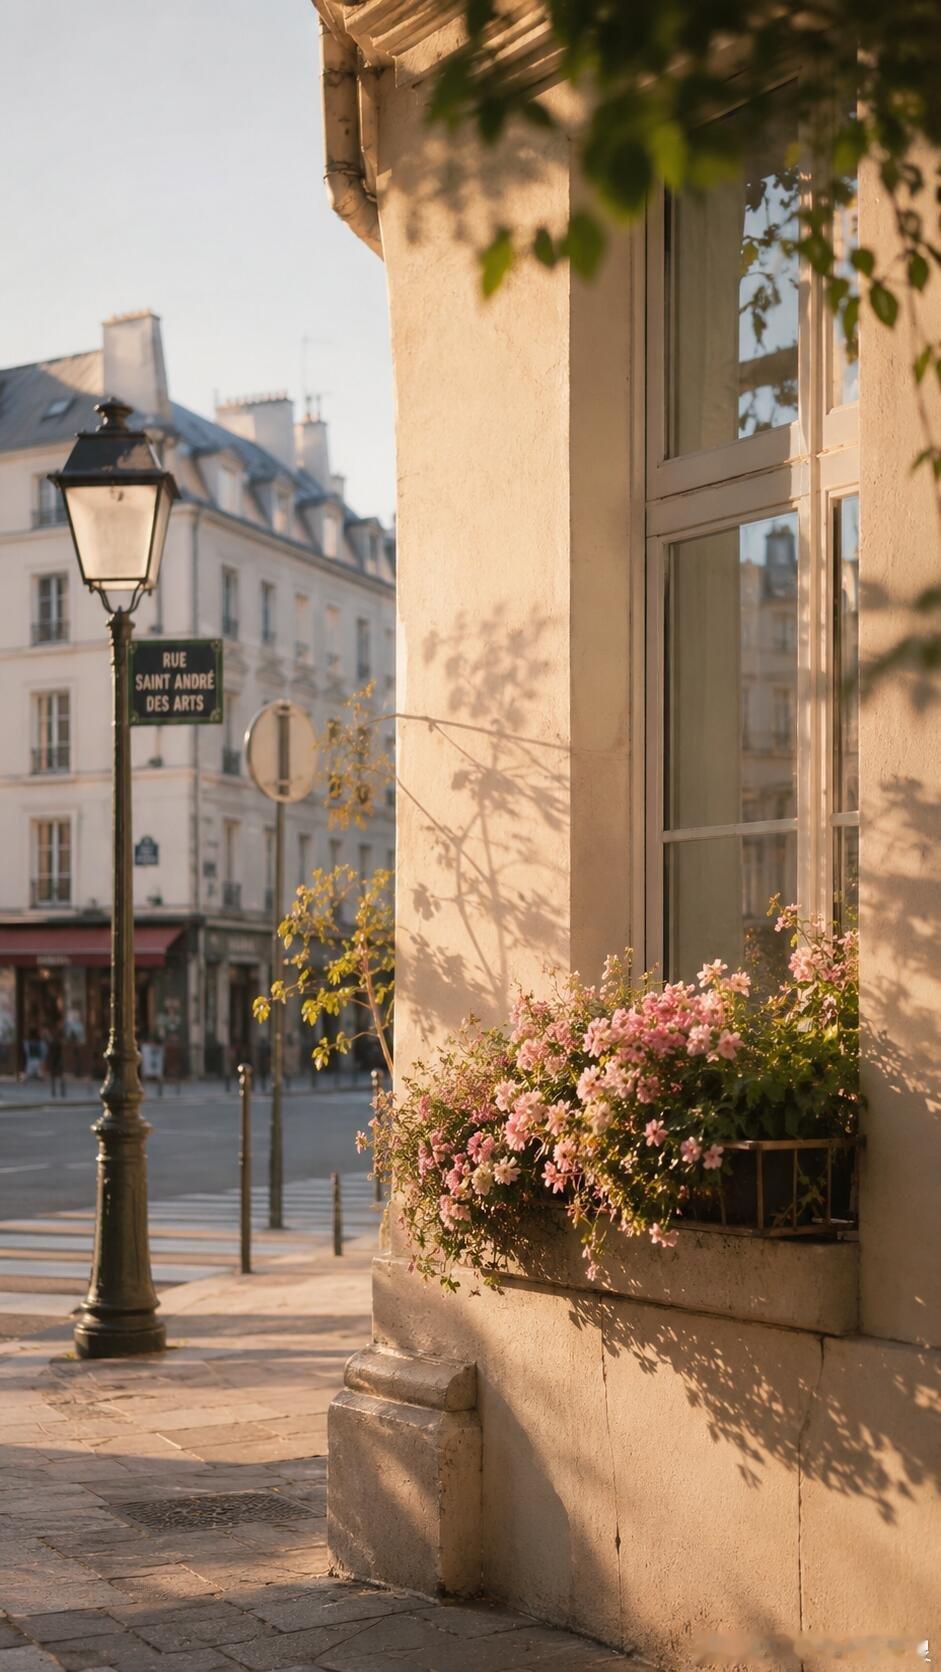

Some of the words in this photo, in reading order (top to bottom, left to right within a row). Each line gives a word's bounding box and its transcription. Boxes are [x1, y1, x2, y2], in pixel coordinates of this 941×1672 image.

[163, 651, 187, 668] RUE
[136, 673, 171, 690] SAINT
[174, 669, 215, 690] ANDRÉ
[146, 695, 170, 712] DES
[173, 695, 204, 712] ARTS
